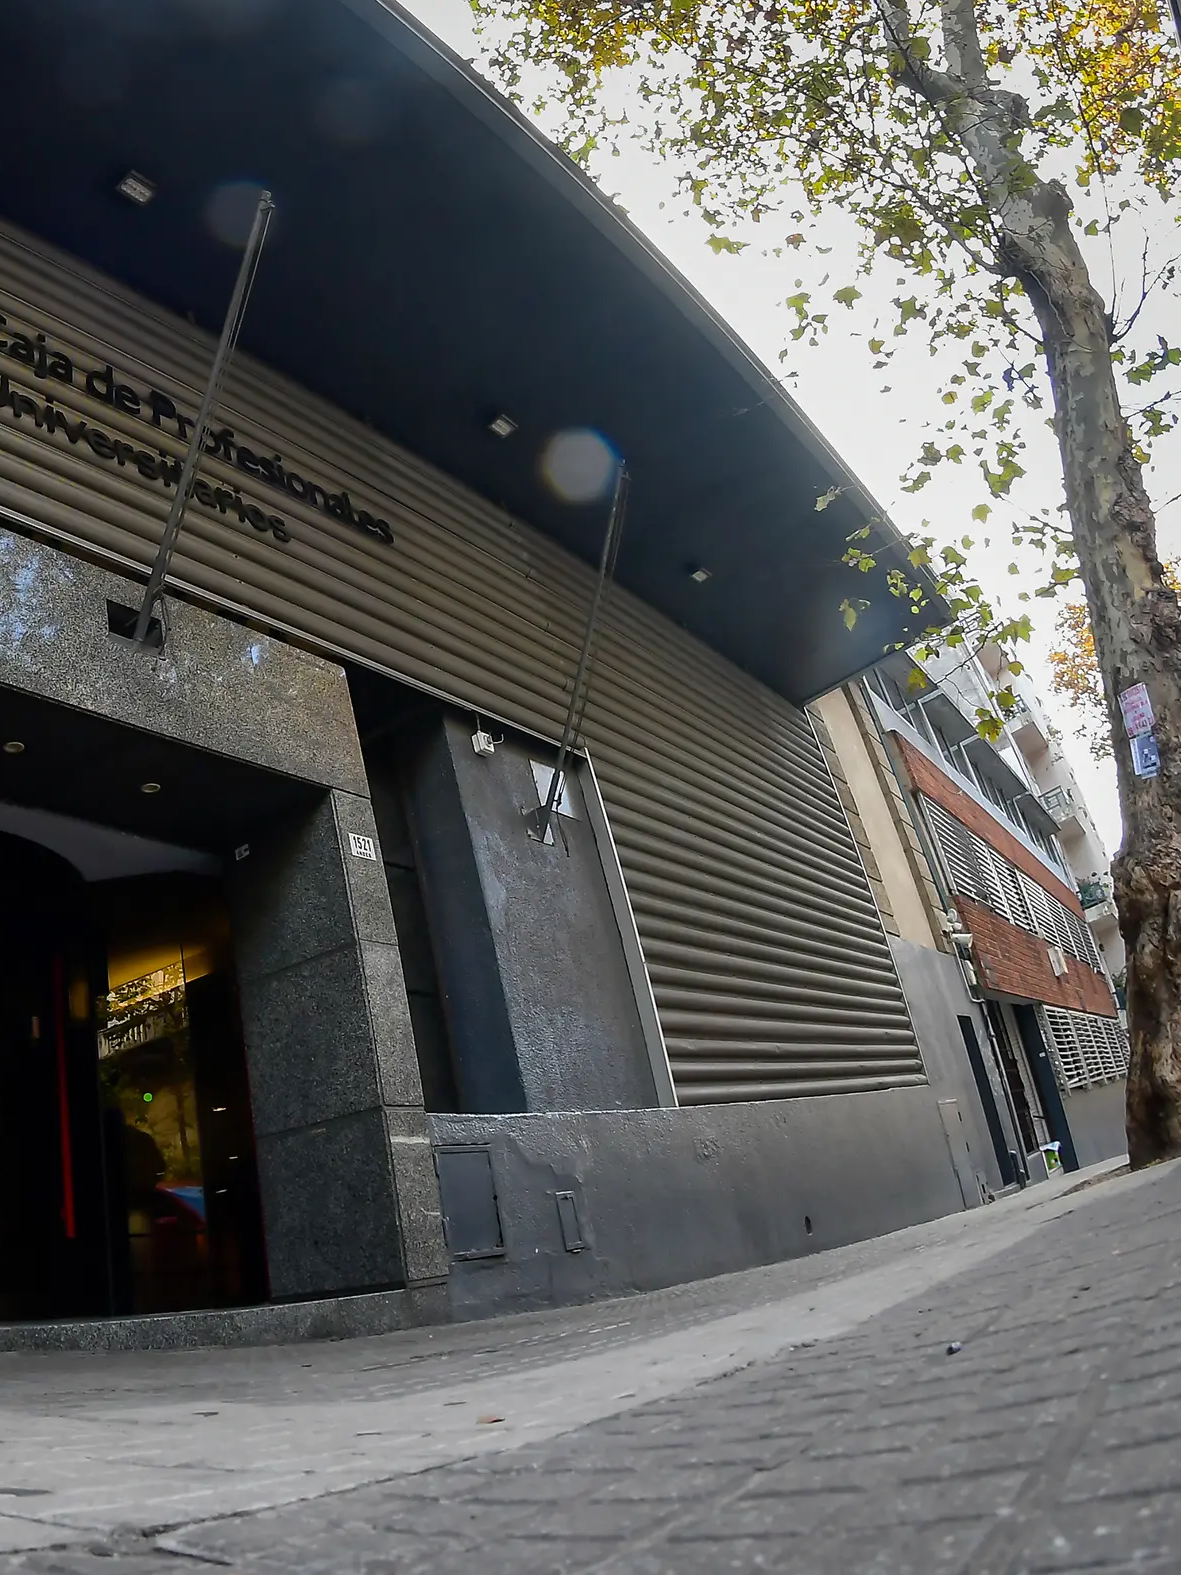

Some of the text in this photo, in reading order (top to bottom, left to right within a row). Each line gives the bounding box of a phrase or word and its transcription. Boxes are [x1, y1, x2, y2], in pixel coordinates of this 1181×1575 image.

[85, 364, 141, 415] de
[149, 389, 395, 545] Profesionales
[353, 835, 372, 852] 1521
